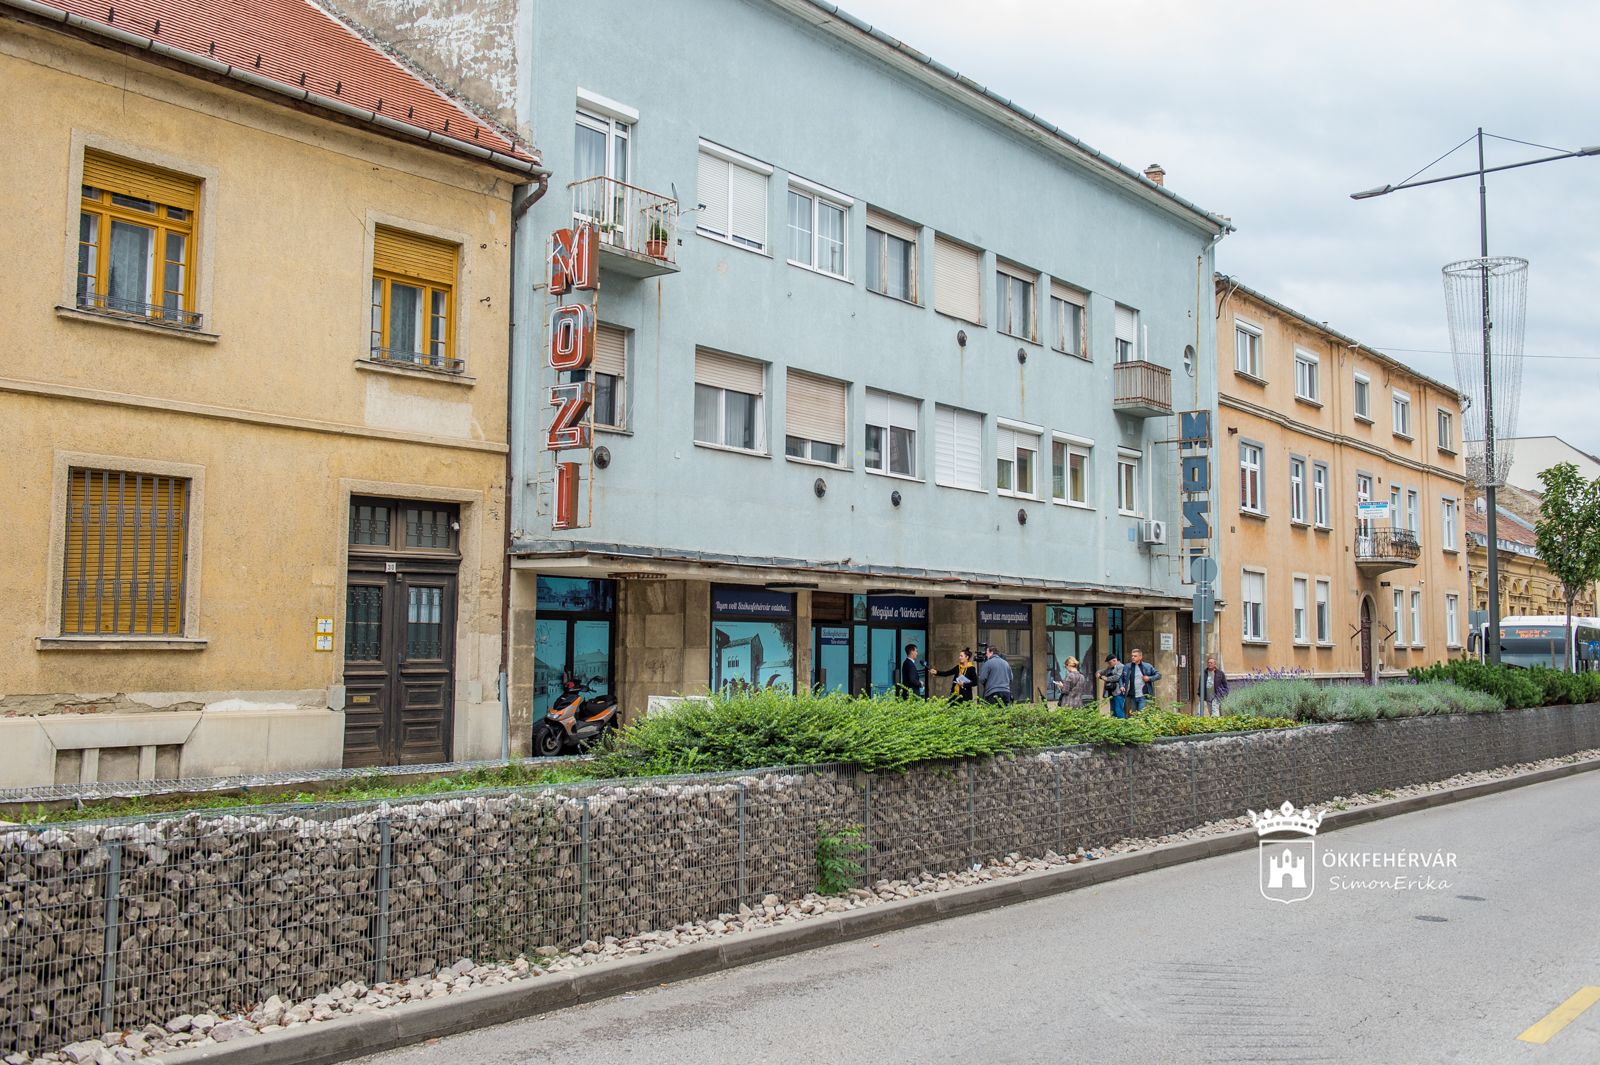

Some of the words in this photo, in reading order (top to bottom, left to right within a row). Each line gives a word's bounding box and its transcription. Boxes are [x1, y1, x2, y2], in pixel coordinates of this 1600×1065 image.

[547, 222, 599, 530] MOZI
[871, 605, 894, 620] Megújul
[894, 609, 899, 618] a
